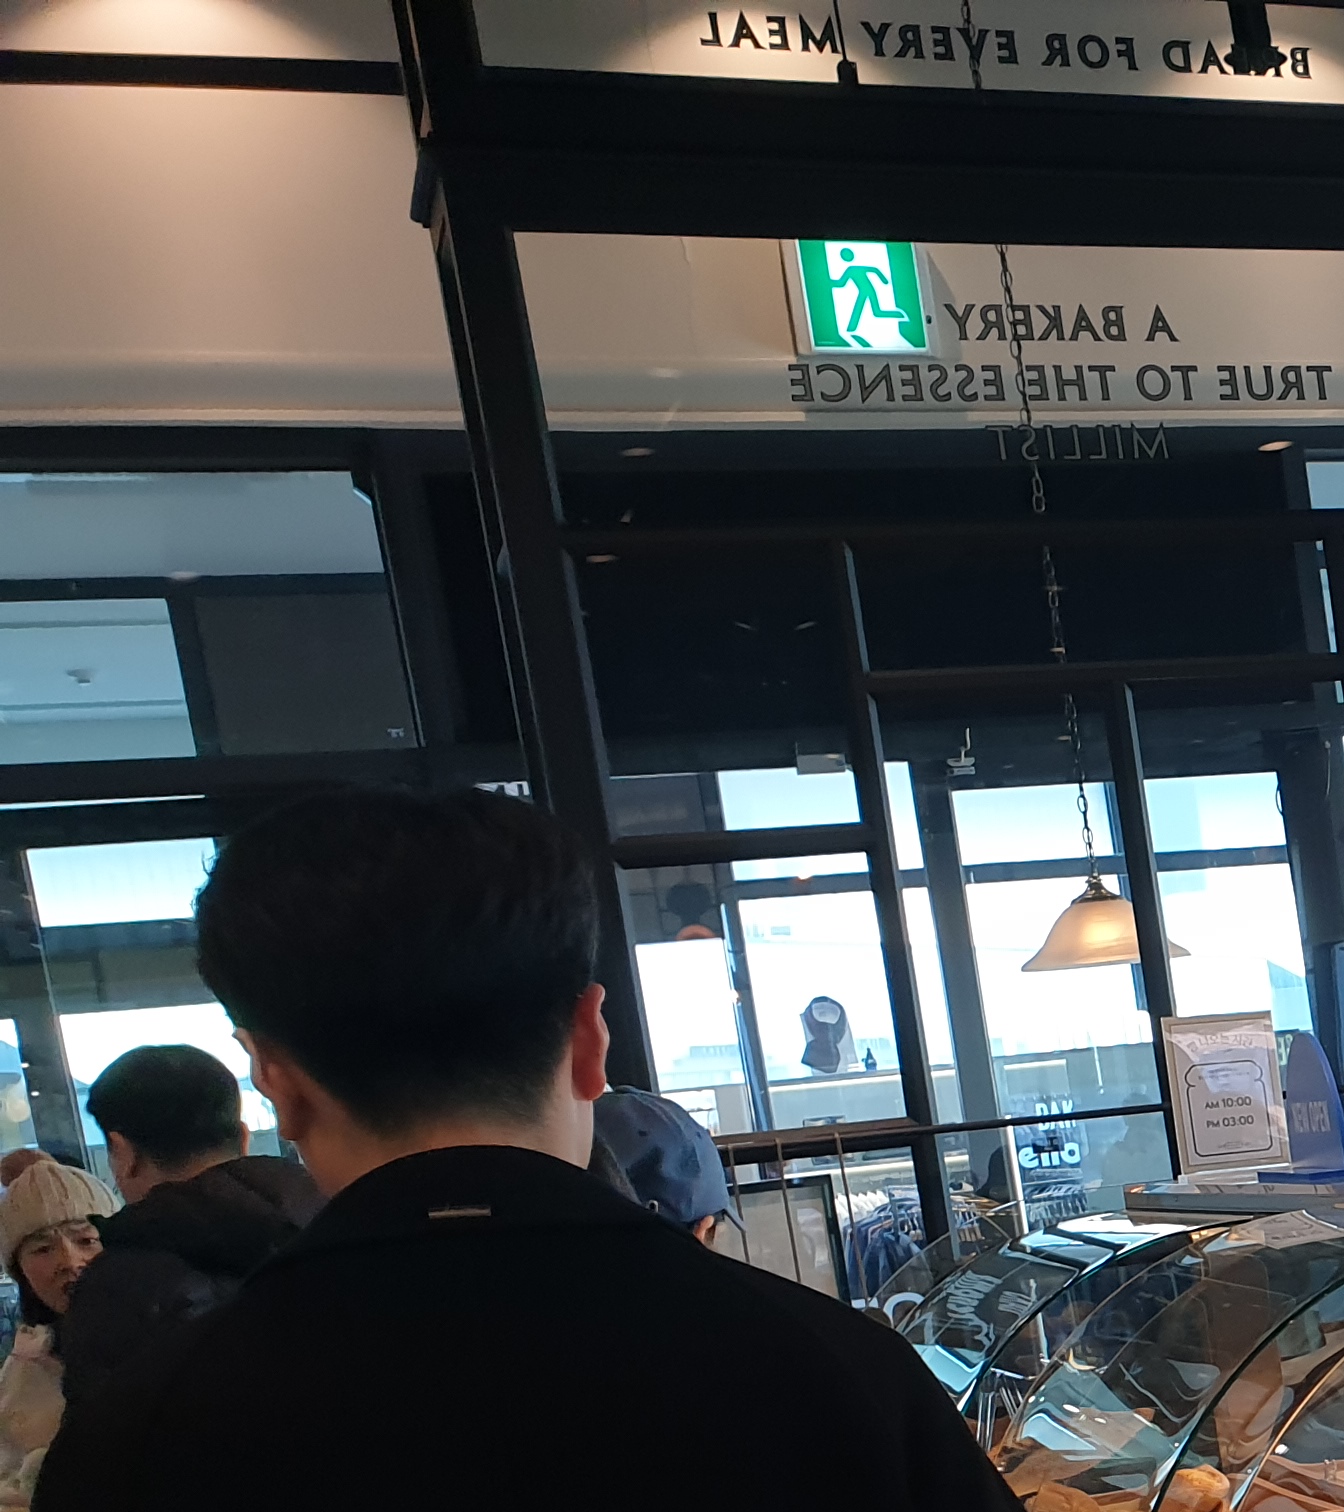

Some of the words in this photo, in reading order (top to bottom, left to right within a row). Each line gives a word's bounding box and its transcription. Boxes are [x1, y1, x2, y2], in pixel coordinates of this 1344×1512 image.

[1204, 1101, 1220, 1110] AM
[1221, 1095, 1252, 1109] 10:00
[1206, 1119, 1220, 1129] PM
[1222, 1114, 1255, 1128] 03:00
